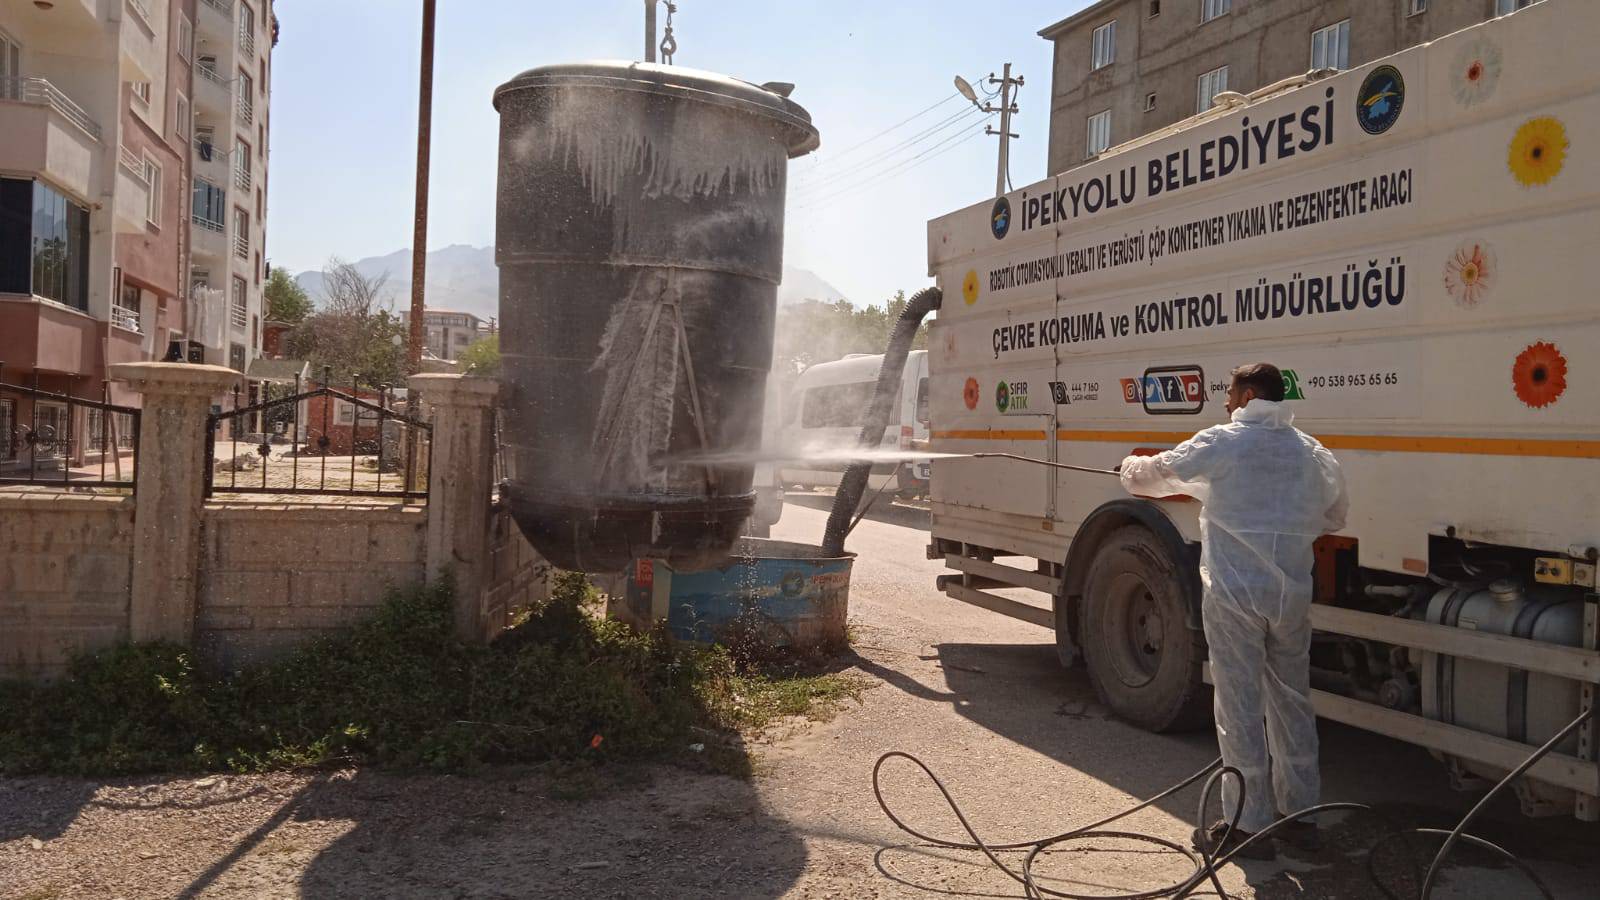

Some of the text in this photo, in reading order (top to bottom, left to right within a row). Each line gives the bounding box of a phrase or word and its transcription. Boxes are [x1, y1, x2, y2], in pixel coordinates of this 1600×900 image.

[1021, 86, 1334, 231] İPEKYOLU BELEDİYESİ
[990, 262, 1015, 292] ROBOTİK
[1066, 246, 1095, 276] YERALTI
[1096, 244, 1106, 270] VE
[1108, 230, 1145, 266] YERÜSTÜ
[1149, 225, 1166, 266] ÇÖP
[1168, 216, 1224, 255] KONTEYNER
[1227, 205, 1266, 242] YIKAMA
[1269, 201, 1284, 233] VE
[1287, 180, 1366, 230] DEZENFEKTE
[1370, 168, 1412, 211] ARACI
[992, 257, 1406, 359] ÇEVRE KORUMA ve KONTROL MÜDÜRLÜĞÜ
[1083, 382, 1087, 392] 7
[1308, 372, 1398, 388] +90 538 963 65 65
[1010, 382, 1028, 395] SIFIR
[1010, 396, 1028, 410] ATIK
